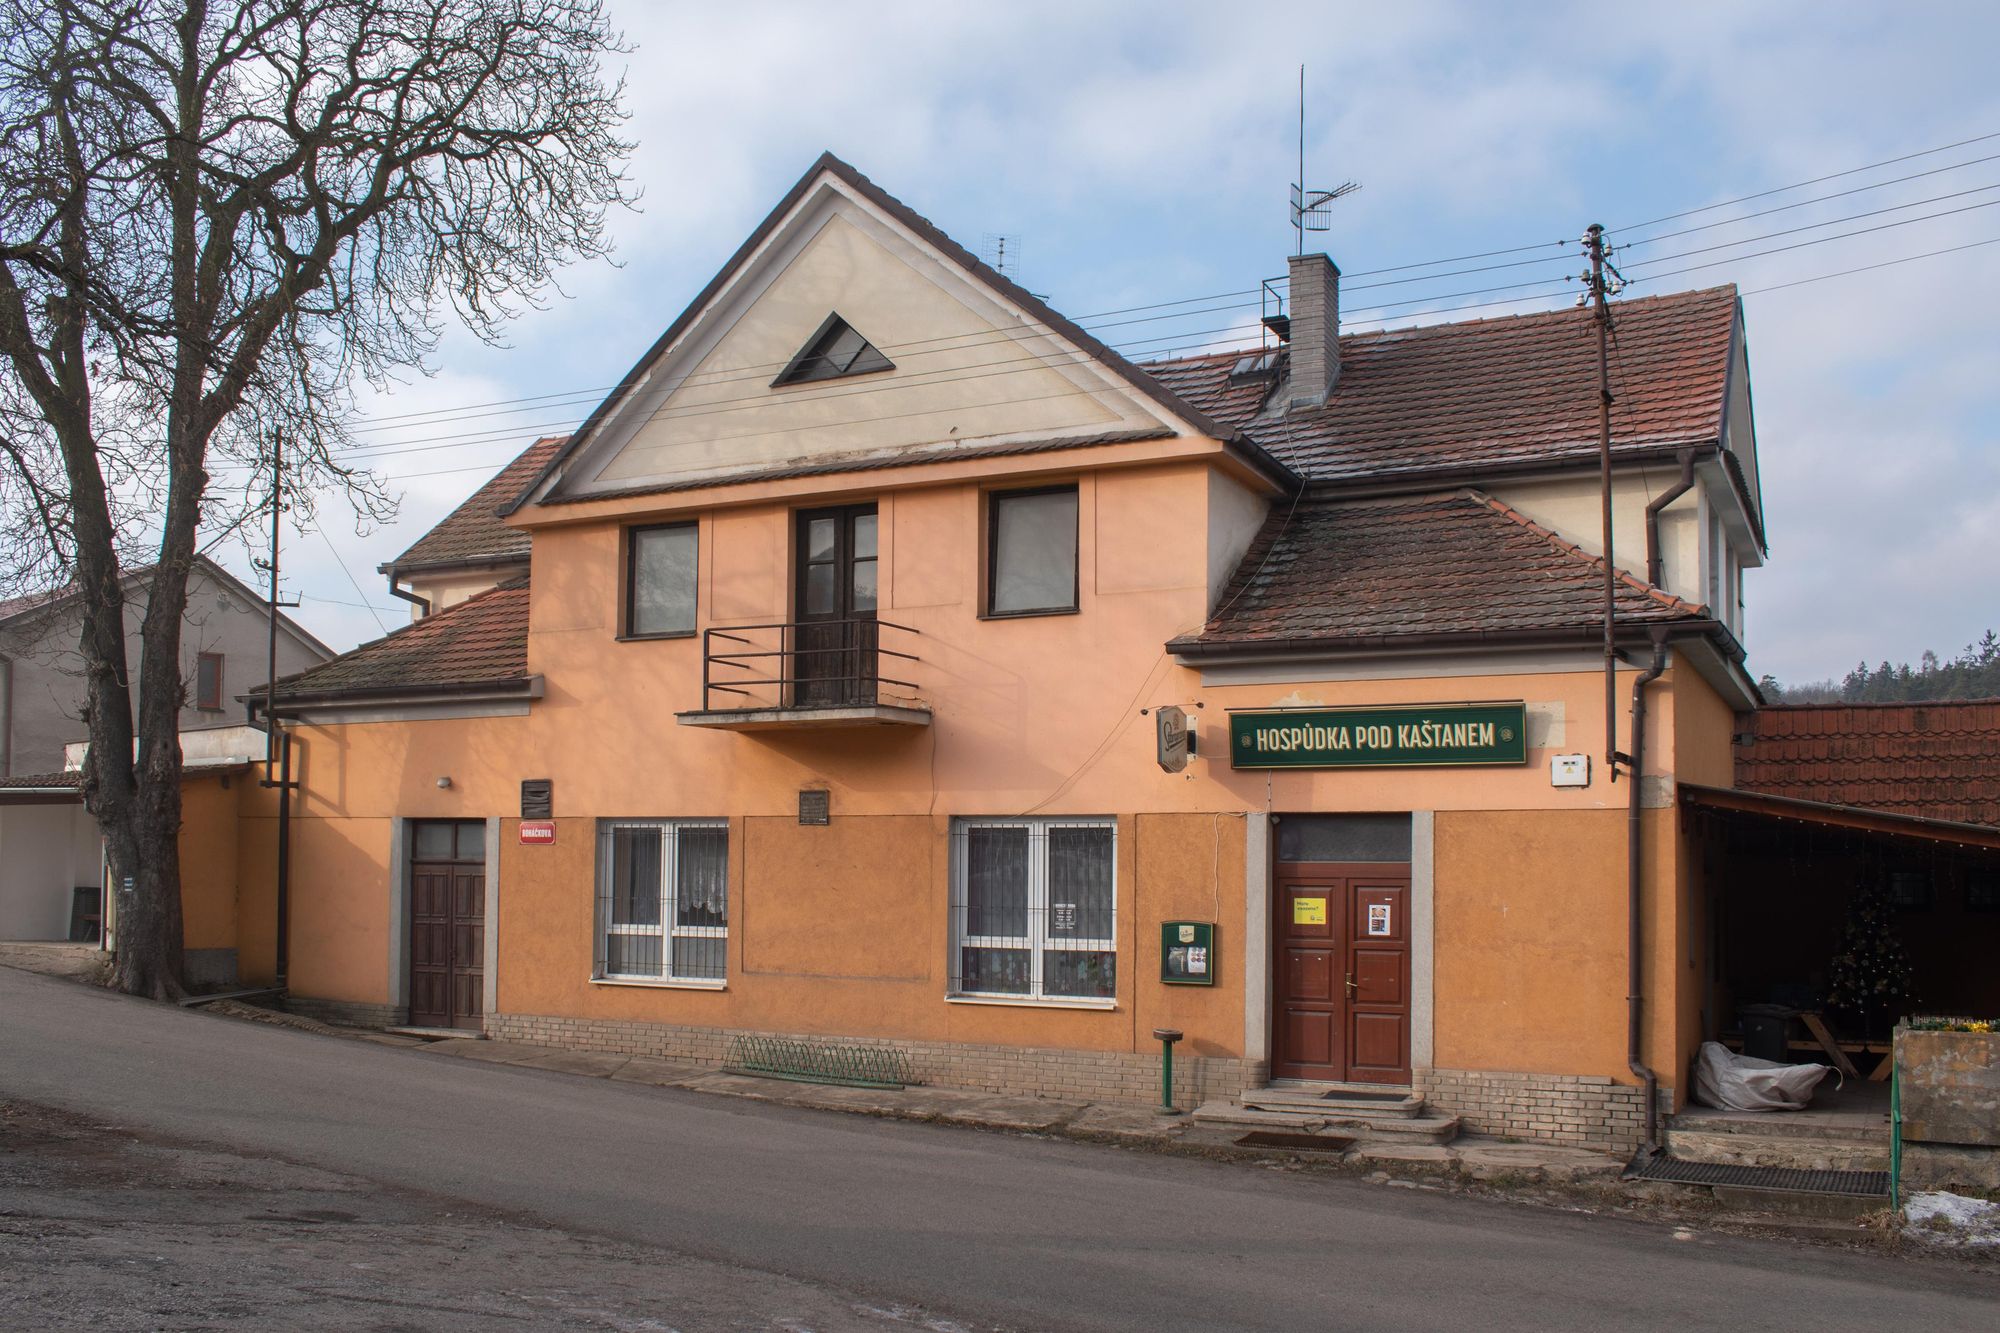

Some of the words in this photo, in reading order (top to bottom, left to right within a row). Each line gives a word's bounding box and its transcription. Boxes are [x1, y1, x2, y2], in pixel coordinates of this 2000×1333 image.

[1256, 723, 1350, 750] HOSPŮDKA
[1356, 725, 1392, 749] POD
[1398, 719, 1494, 748] KAŠTANEM
